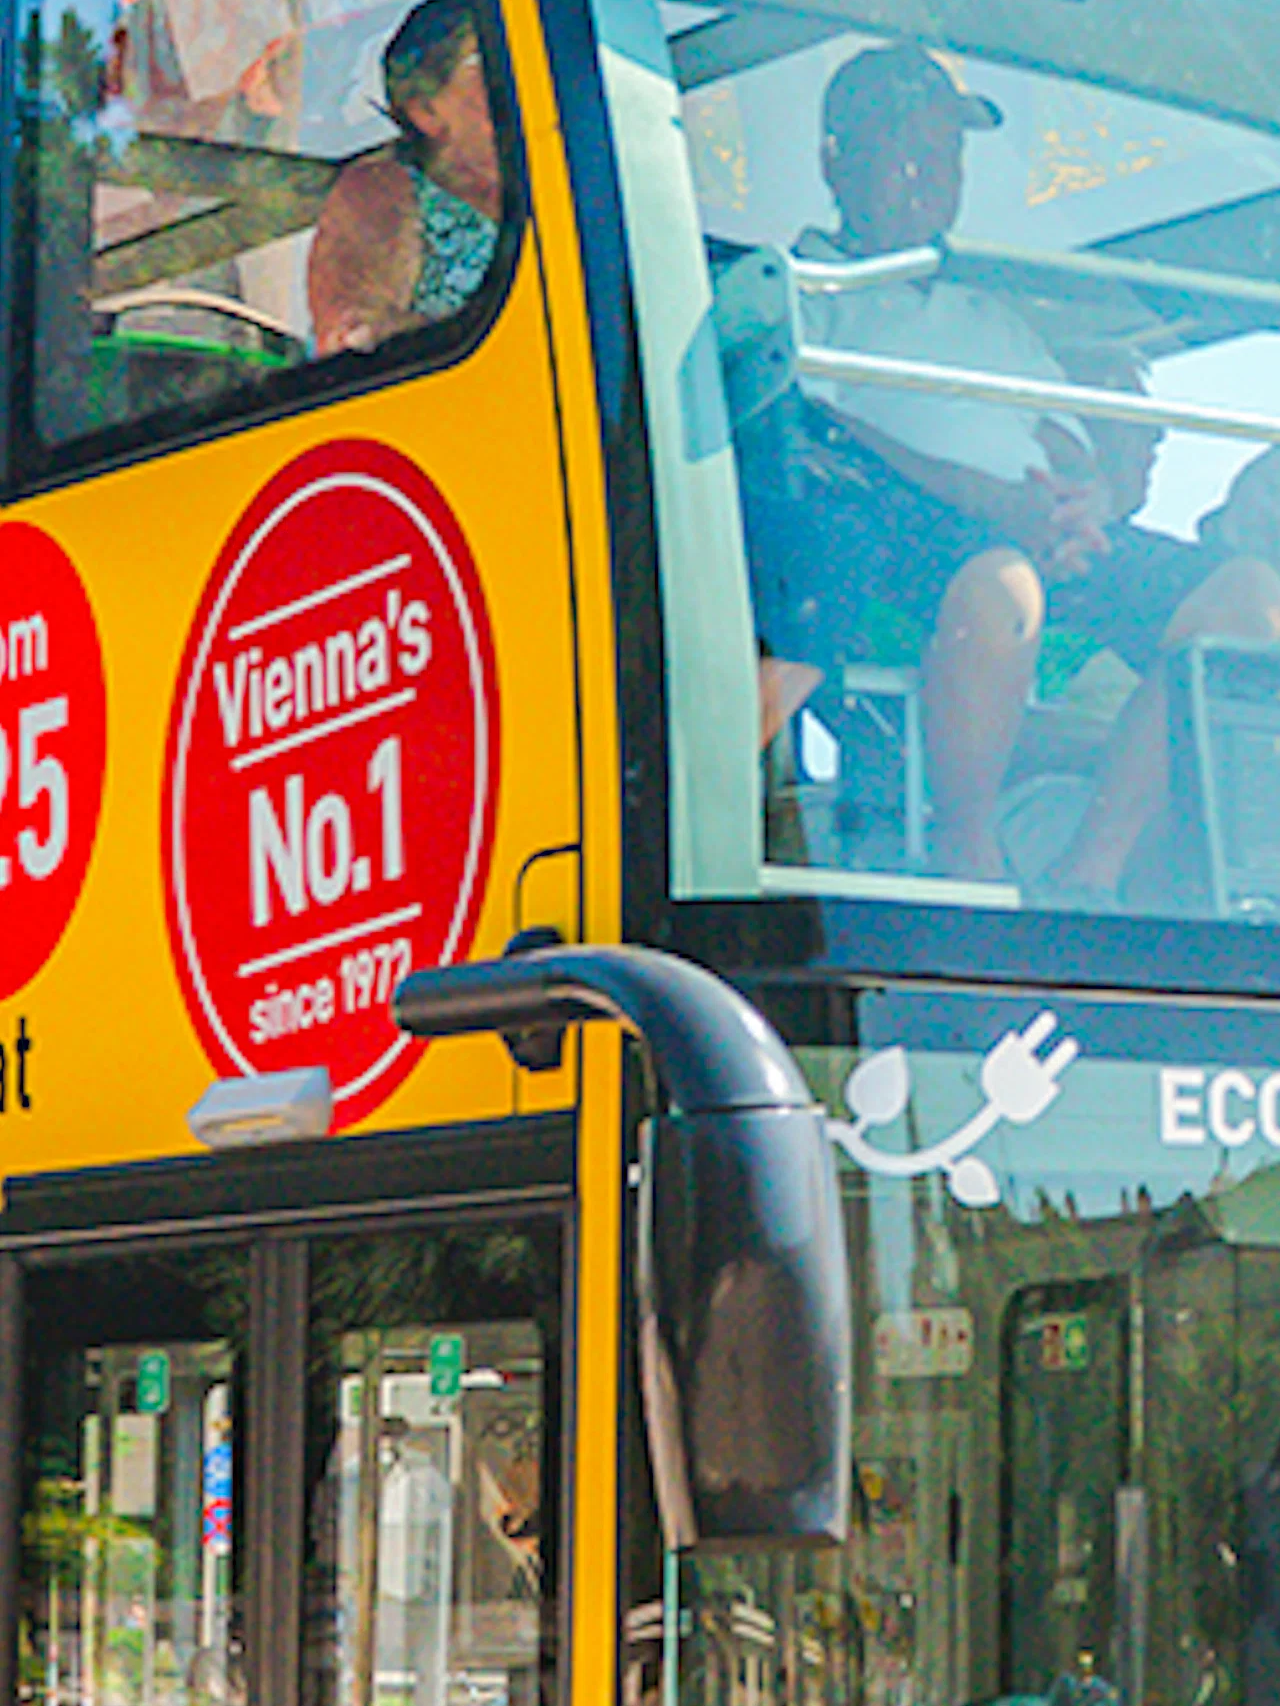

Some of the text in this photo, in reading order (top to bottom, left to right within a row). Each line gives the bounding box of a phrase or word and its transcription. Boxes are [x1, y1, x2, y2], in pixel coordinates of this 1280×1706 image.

[213, 589, 432, 747] Vienna's
[248, 735, 405, 928] No.1
[248, 979, 336, 1044] since
